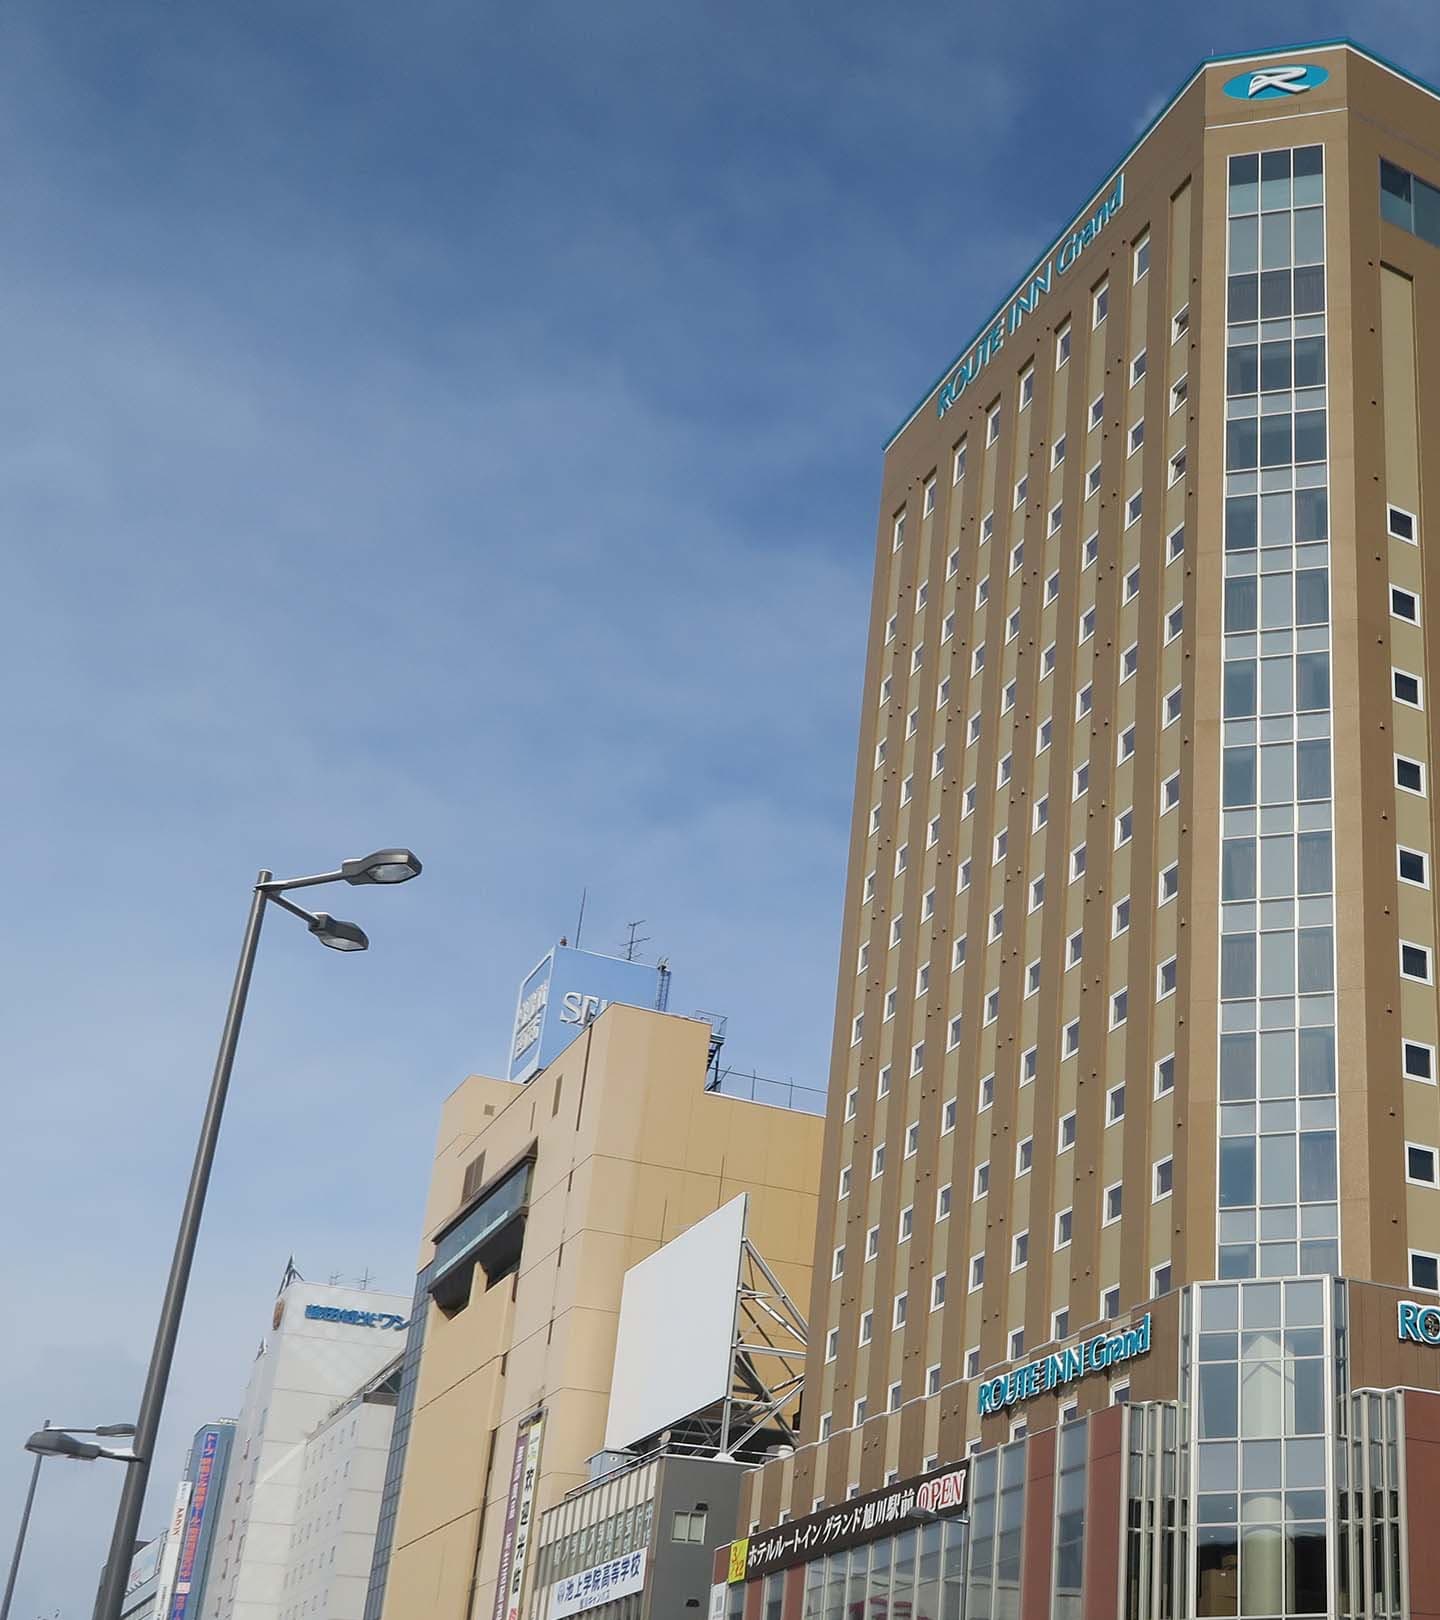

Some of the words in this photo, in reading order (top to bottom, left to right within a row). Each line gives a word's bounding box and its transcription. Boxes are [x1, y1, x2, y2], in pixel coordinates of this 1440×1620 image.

[937, 316, 1005, 420] ROUTE
[1008, 260, 1052, 336] INN
[1056, 172, 1125, 275] Grand
[977, 1361, 1041, 1416] ROUTE
[1044, 1343, 1084, 1390] INN
[1089, 1312, 1152, 1371] Grand
[917, 1469, 966, 1512] OPEN
